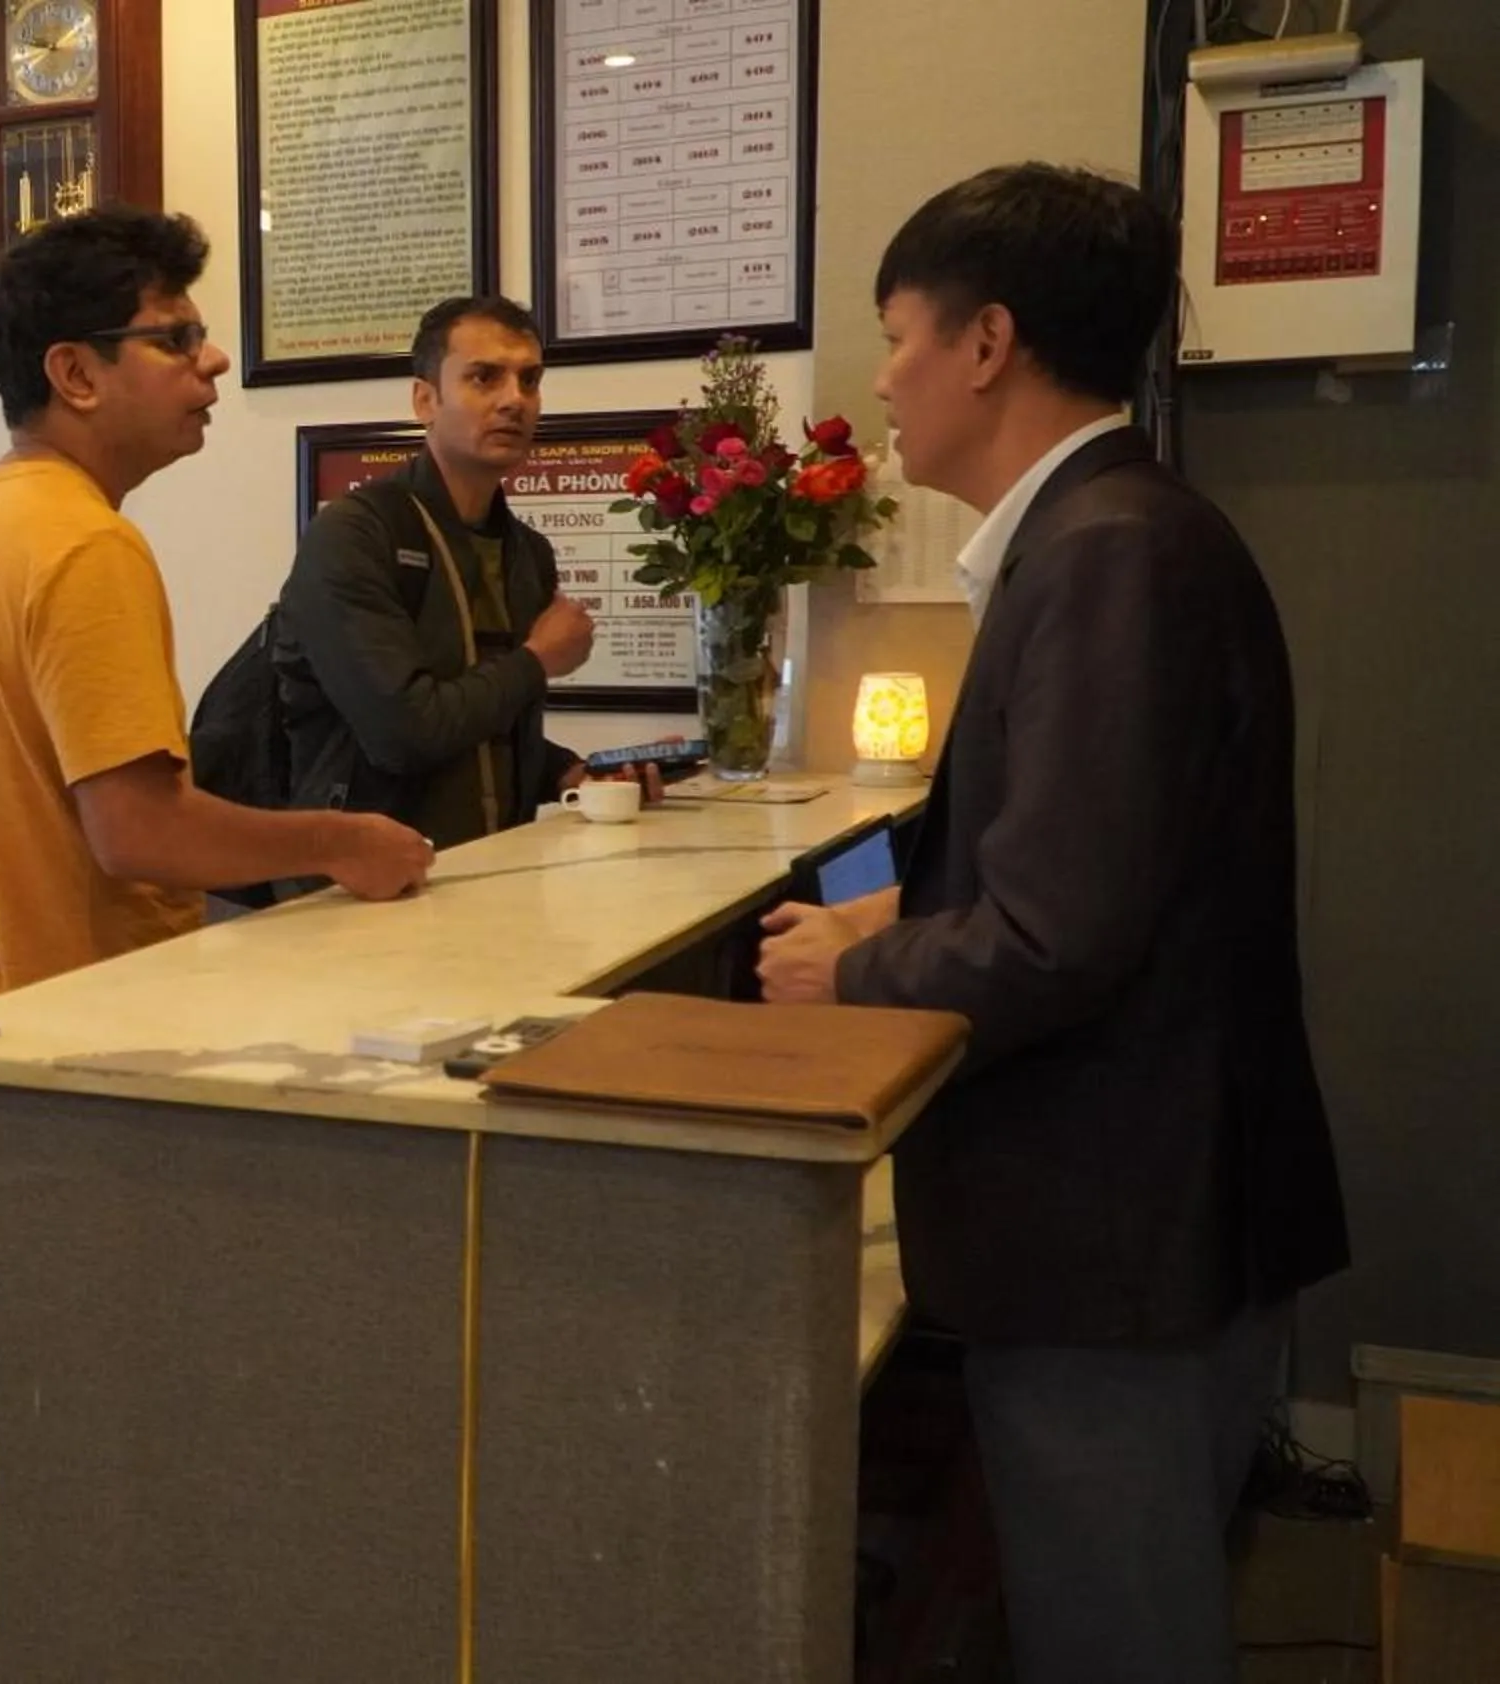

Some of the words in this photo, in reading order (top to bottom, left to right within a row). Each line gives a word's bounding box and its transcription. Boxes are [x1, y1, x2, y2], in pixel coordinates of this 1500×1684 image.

[539, 447, 577, 458] SAPA
[582, 445, 624, 456] SNOW
[514, 471, 551, 493] GIÁ
[541, 509, 604, 527] PHÒNG
